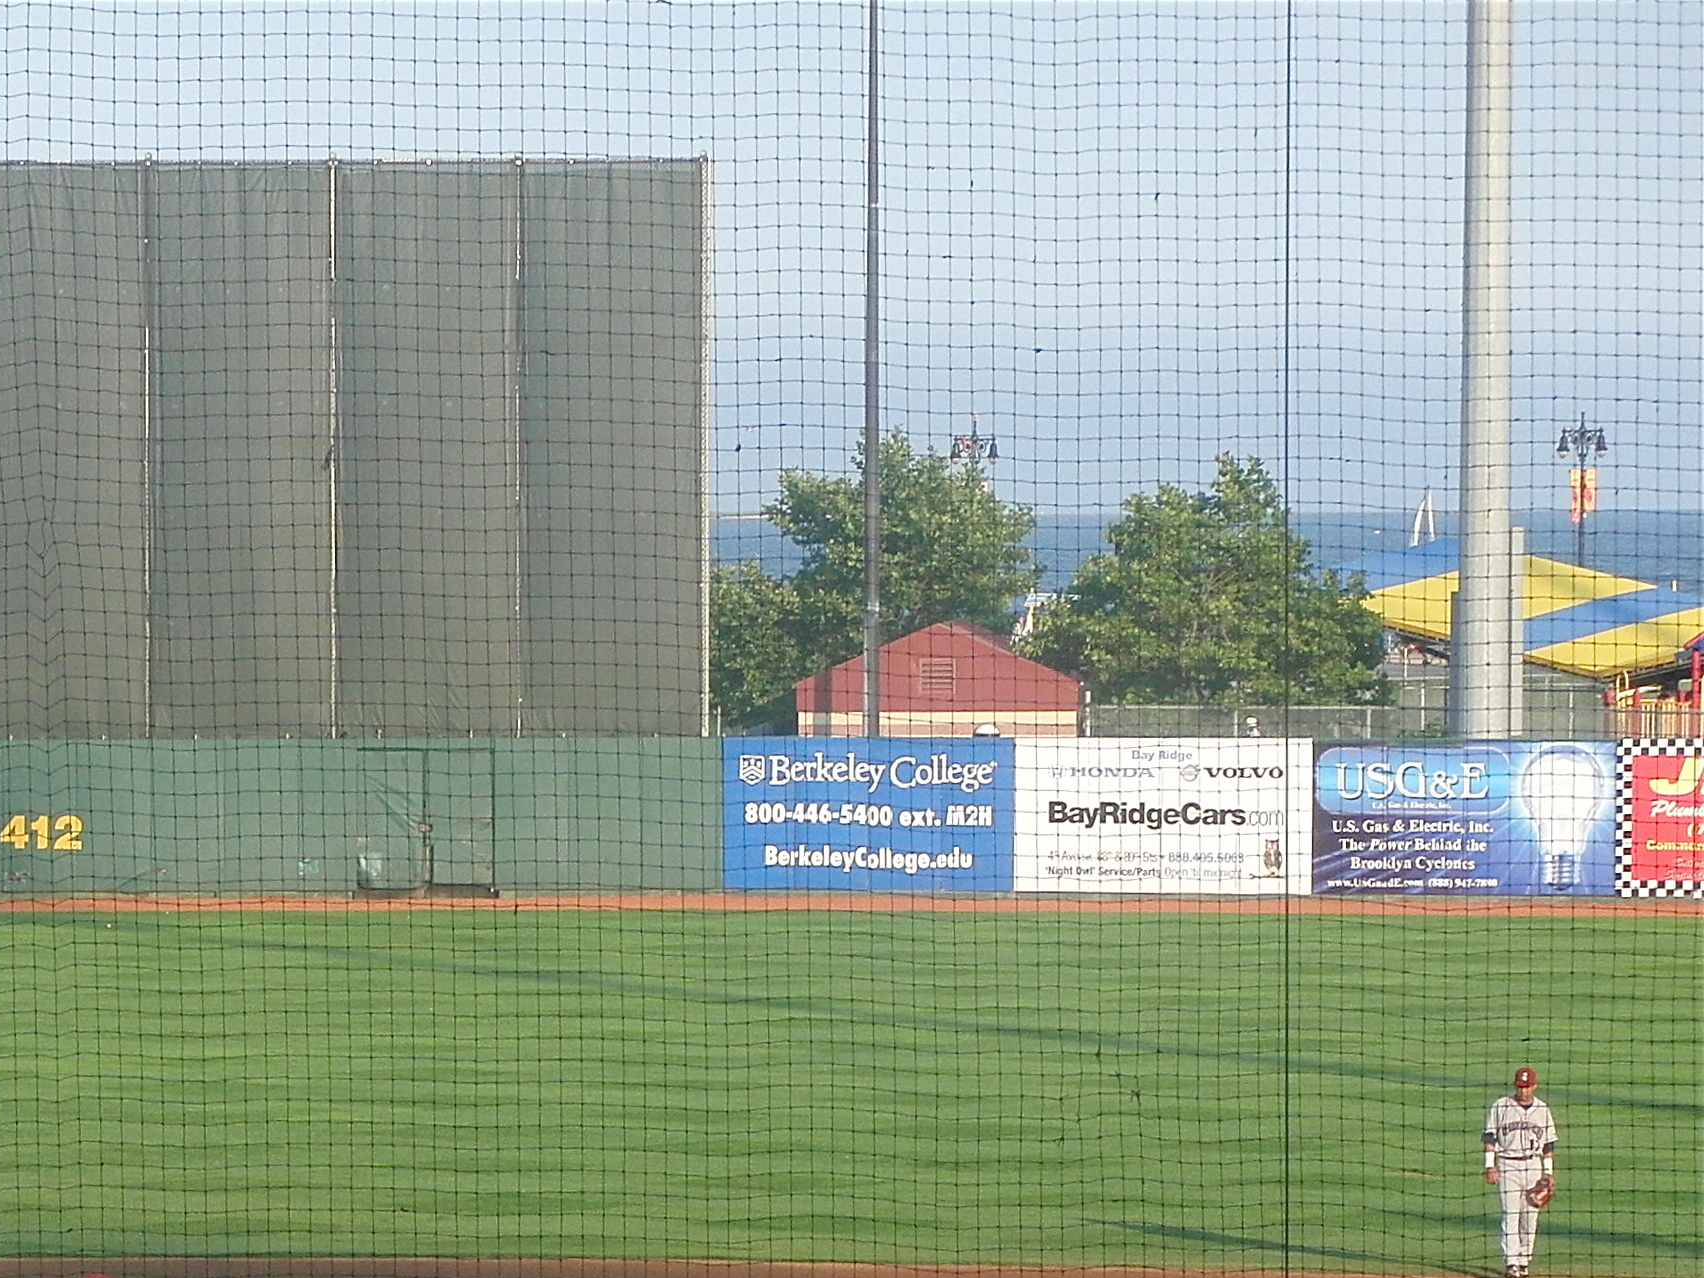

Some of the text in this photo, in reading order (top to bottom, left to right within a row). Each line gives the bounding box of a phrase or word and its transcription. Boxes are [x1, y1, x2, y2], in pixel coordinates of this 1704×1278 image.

[1131, 750, 1193, 763] Bay Ridge
[768, 752, 993, 793] Berkeley College
[1069, 766, 1156, 778] HONDA
[1203, 766, 1285, 780] VOLVO
[1335, 760, 1490, 799] USG&E
[744, 803, 993, 827] 800-446-5400 ext. M2H
[1048, 801, 1285, 830] BayRidgeCars.com
[0, 814, 84, 850] 412
[1332, 820, 1495, 835] U.S. Gas & Electric, Inc.
[1338, 838, 1487, 851] The Power Behind the
[764, 845, 974, 875] BerkeleyCollege.edu
[1350, 856, 1476, 872] Brooklyn Cyclones
